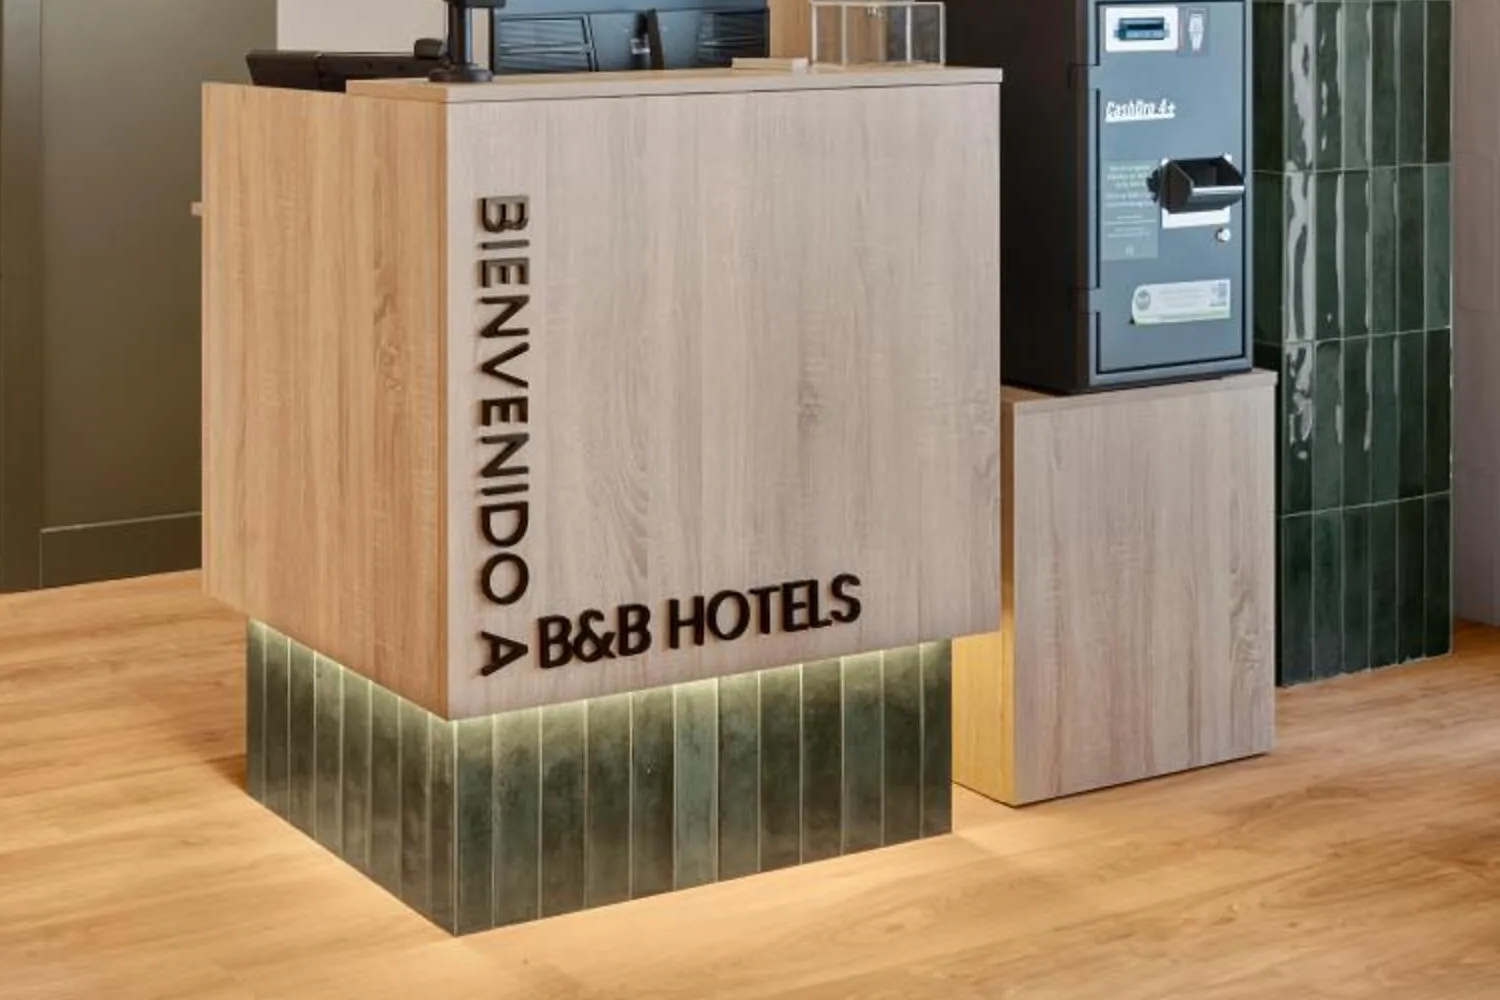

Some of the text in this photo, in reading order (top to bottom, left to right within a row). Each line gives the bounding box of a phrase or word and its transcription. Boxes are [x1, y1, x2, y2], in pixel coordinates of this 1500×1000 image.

[479, 195, 530, 676] BIENVENIDO A
[537, 573, 862, 669] B&B HOTELS
